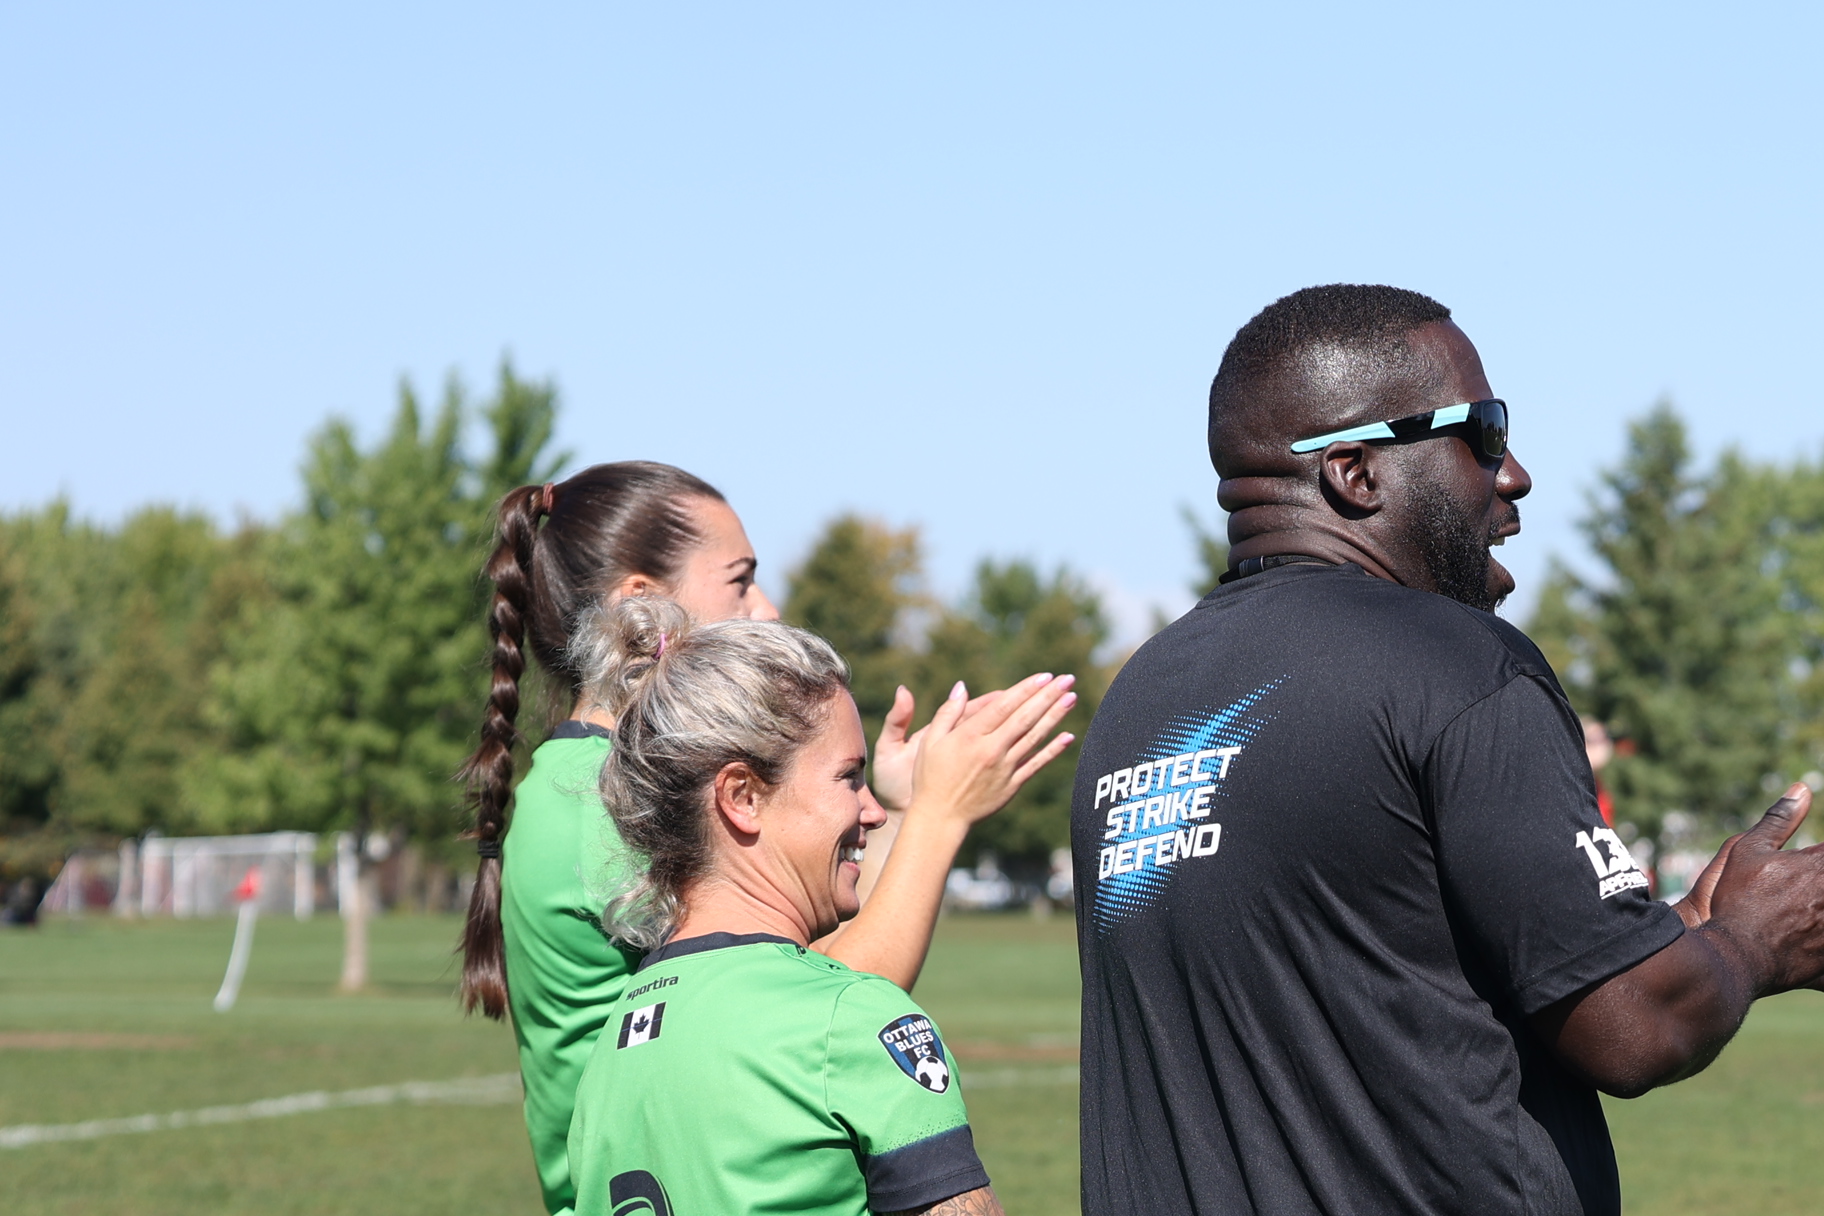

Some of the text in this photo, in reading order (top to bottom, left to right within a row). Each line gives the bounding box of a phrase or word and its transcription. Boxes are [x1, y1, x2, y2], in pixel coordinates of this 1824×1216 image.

[1094, 746, 1242, 810] PROTECT
[1104, 785, 1216, 840] STRIKE
[1098, 822, 1222, 881] DEFEND
[625, 975, 679, 1001] sportira
[883, 1019, 933, 1044] OTTAWA
[894, 1031, 934, 1053] BLUES
[913, 1045, 931, 1059] FC
